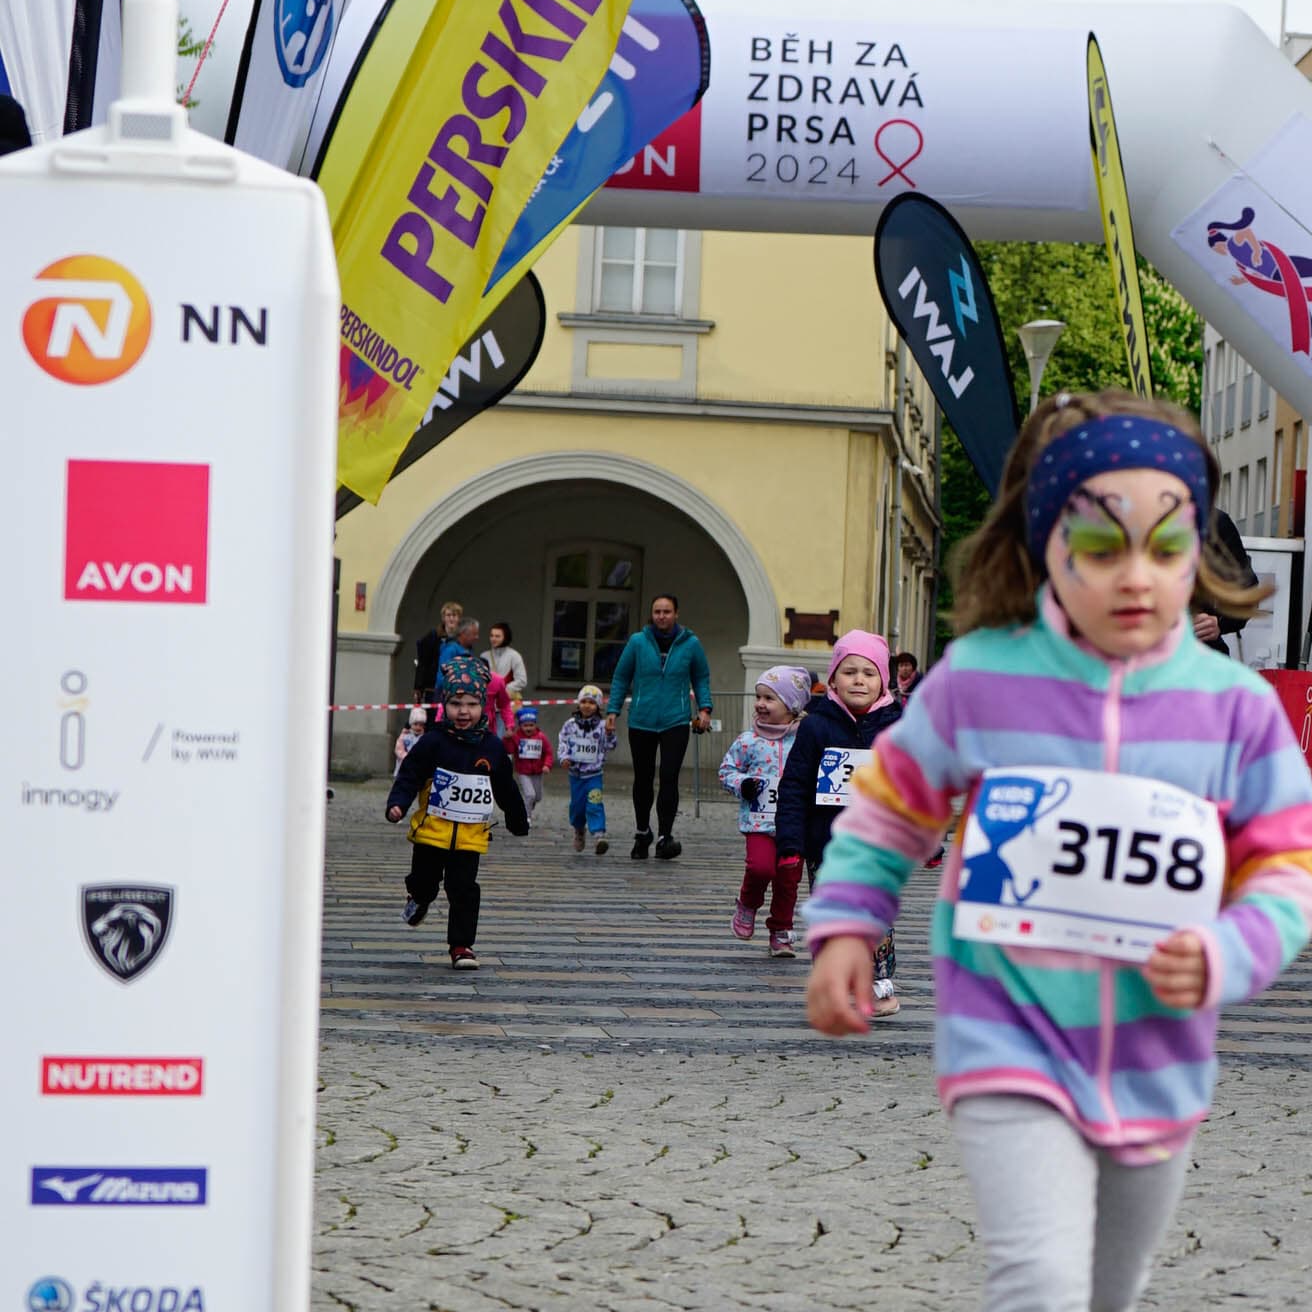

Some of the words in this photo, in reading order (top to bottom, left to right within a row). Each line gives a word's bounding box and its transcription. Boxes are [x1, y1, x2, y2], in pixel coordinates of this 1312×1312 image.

[750, 33, 833, 65] BĚH
[855, 41, 909, 69] ZA
[747, 72, 924, 108] ZDRAVÁ
[747, 113, 856, 145] PRSA
[746, 153, 861, 185] 2024
[180, 303, 268, 347] NN
[340, 304, 420, 391] PERSKINDOL
[416, 330, 505, 432] AWI
[76, 561, 193, 594] AVON
[20, 781, 119, 813] innogy
[449, 785, 492, 805] 3028
[984, 803, 1030, 822] CUP
[1051, 820, 1205, 893] 3158
[47, 1062, 200, 1090] NUTREND
